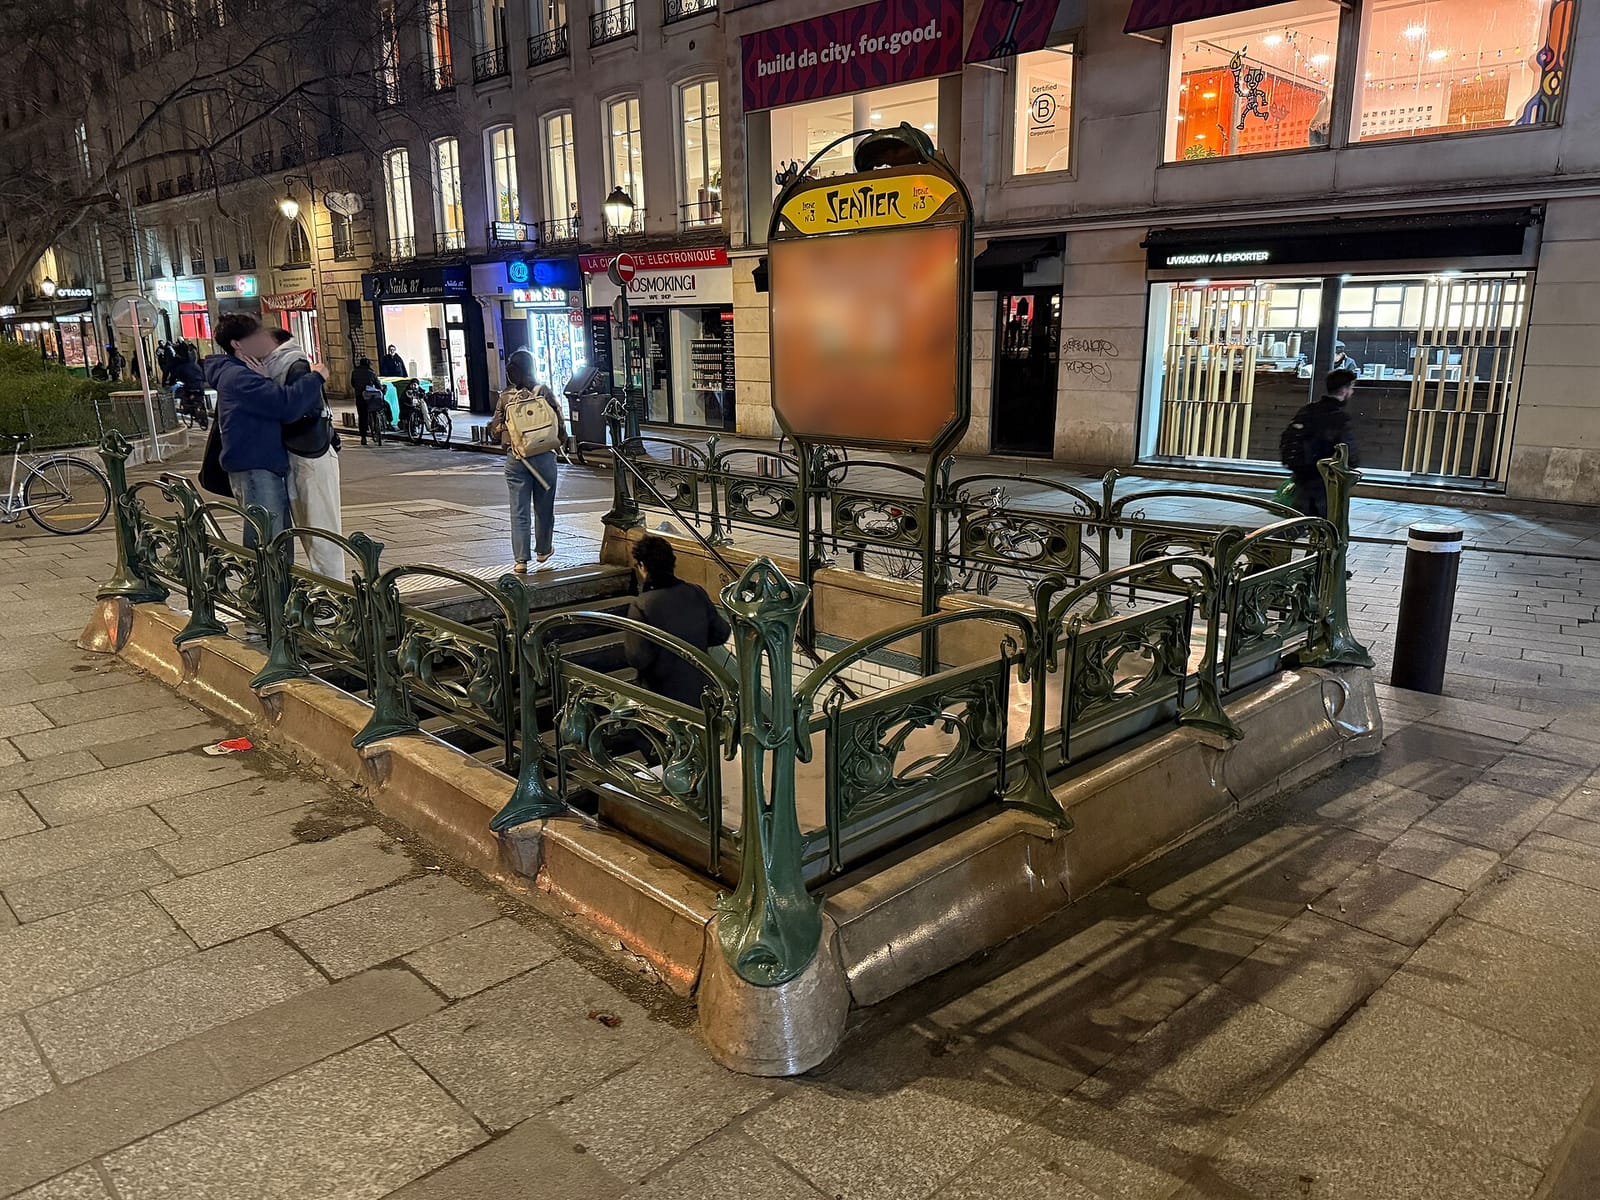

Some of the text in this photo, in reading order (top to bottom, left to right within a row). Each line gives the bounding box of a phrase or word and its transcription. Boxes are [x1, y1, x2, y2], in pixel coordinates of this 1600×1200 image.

[757, 51, 796, 77] build
[798, 48, 818, 68] da
[820, 41, 856, 64] city.
[1031, 83, 1058, 93] Certified
[826, 185, 907, 224] SENTIER
[587, 259, 599, 269] LA
[1166, 254, 1209, 265] LIVRAISON
